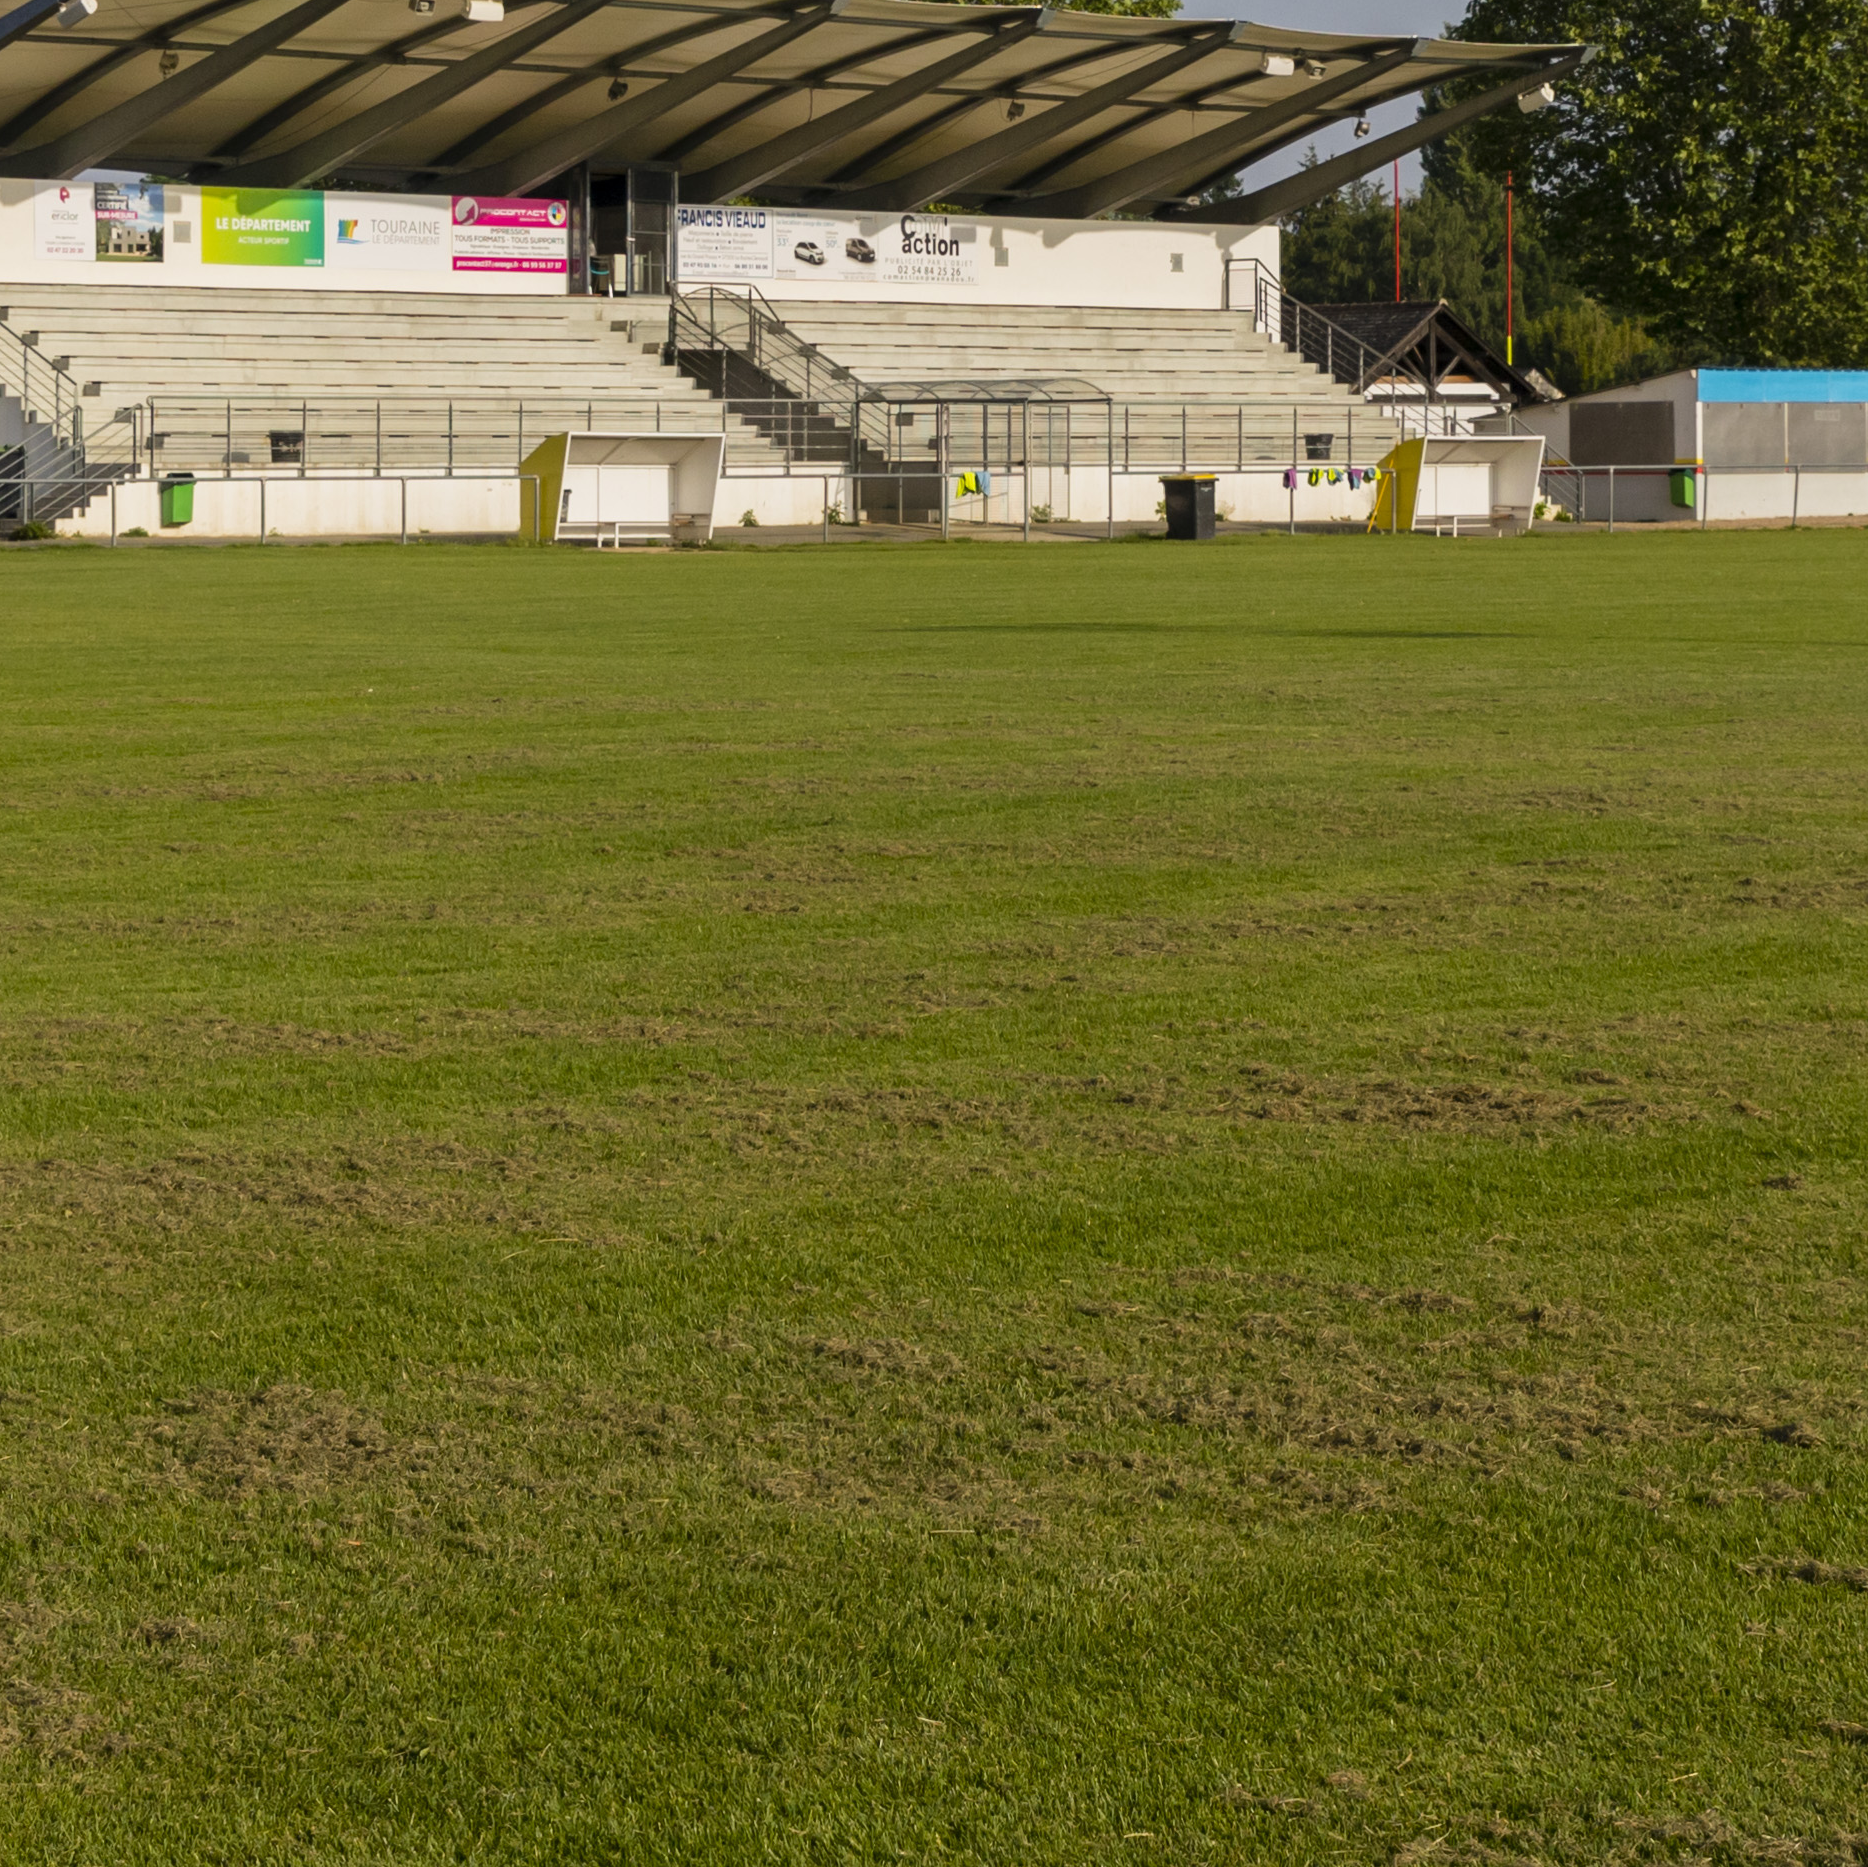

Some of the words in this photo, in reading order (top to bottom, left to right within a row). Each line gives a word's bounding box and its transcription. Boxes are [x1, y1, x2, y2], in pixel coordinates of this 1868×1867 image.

[97, 211, 136, 219] SUR-MESURE
[480, 208, 547, 217] PROCONTACT
[216, 218, 229, 230] LE
[231, 215, 311, 232] DÉPARTEMENT
[725, 210, 766, 229] VIEAUD
[371, 219, 440, 235] TOURAINE
[238, 236, 263, 244] ACTEUR
[264, 237, 289, 245] SPORTIF
[373, 235, 382, 244] LE
[384, 234, 440, 245] DÉPARTEMENT
[474, 235, 505, 243] FORMATS
[902, 232, 960, 256] action
[927, 258, 940, 266] PAR
[944, 259, 973, 267] L'OBJET
[898, 265, 908, 274] 02
[912, 265, 921, 274] 54
[924, 266, 934, 275] 84
[937, 267, 947, 276] 25
[951, 268, 961, 276] 26
